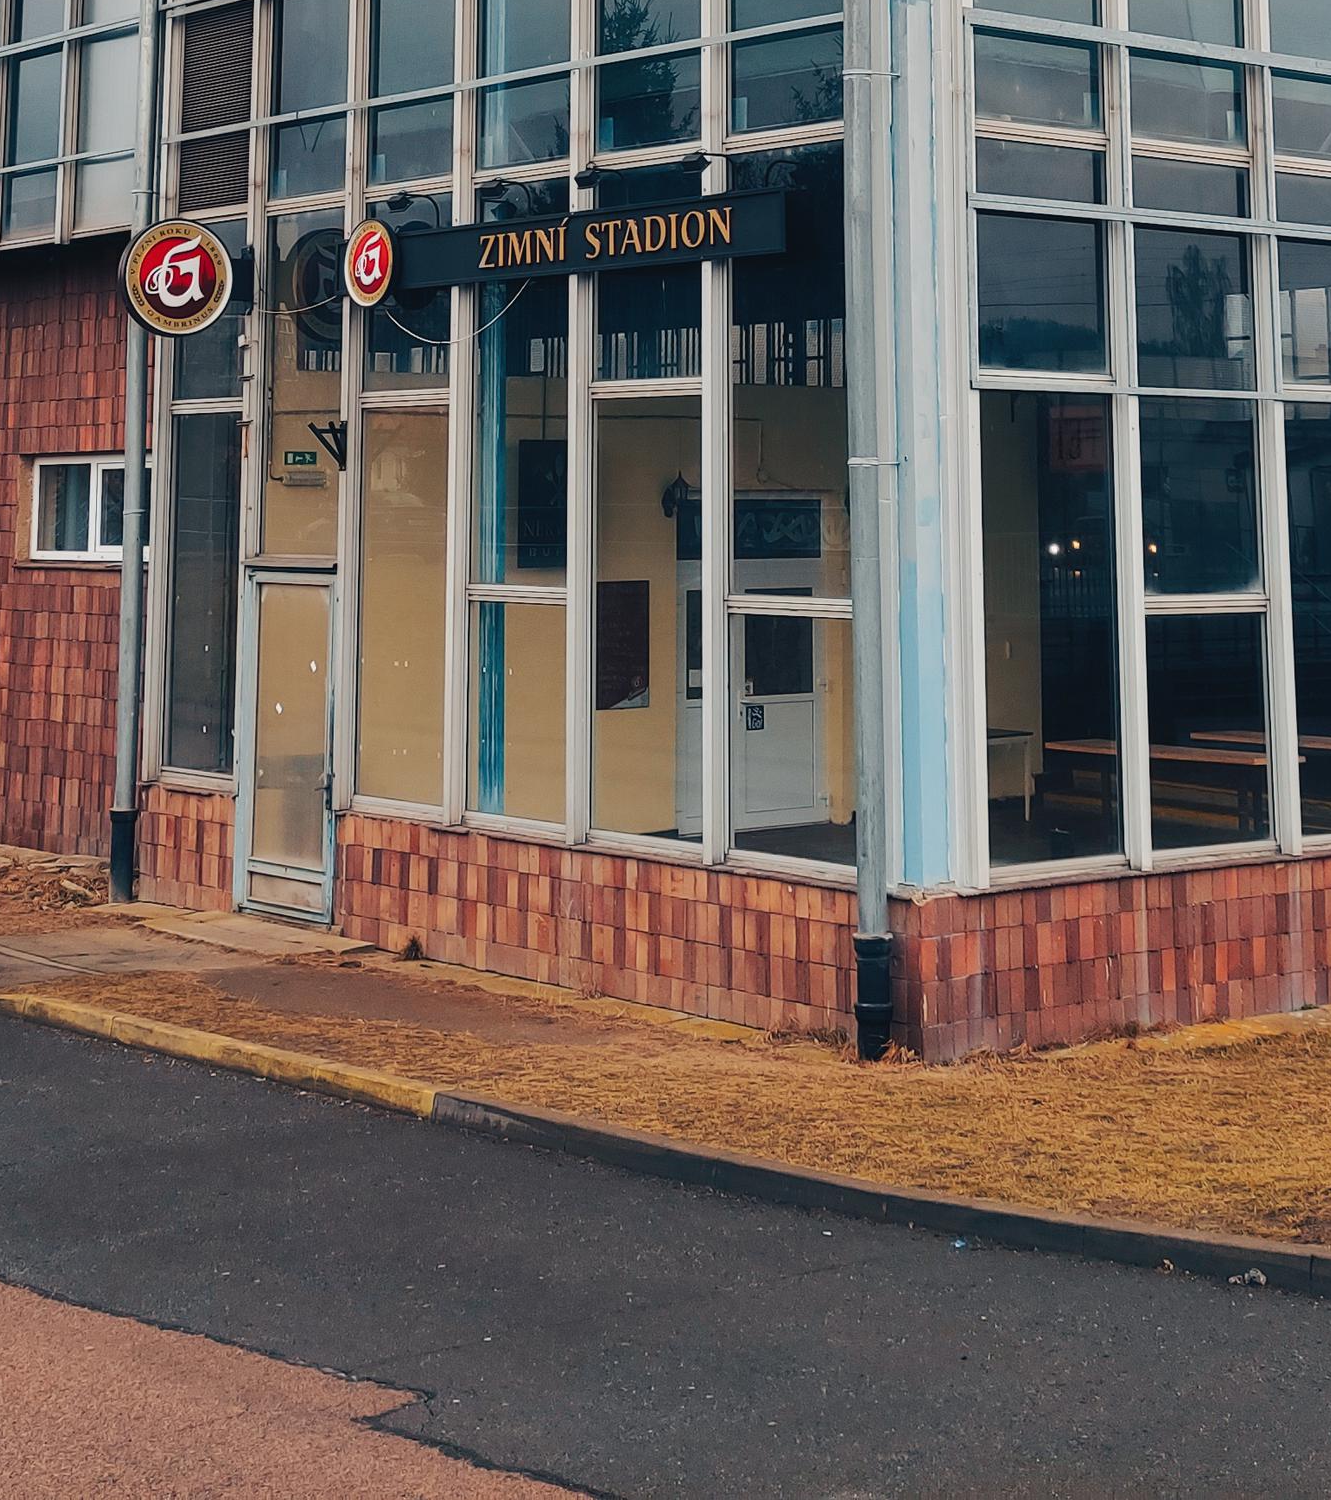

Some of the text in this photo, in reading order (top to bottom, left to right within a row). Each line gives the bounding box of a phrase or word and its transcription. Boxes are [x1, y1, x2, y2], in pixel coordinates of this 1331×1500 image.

[159, 228, 192, 237] ROKU
[478, 206, 733, 269] ZIMNÍ STADION
[147, 307, 214, 328] GAMBRINUS
